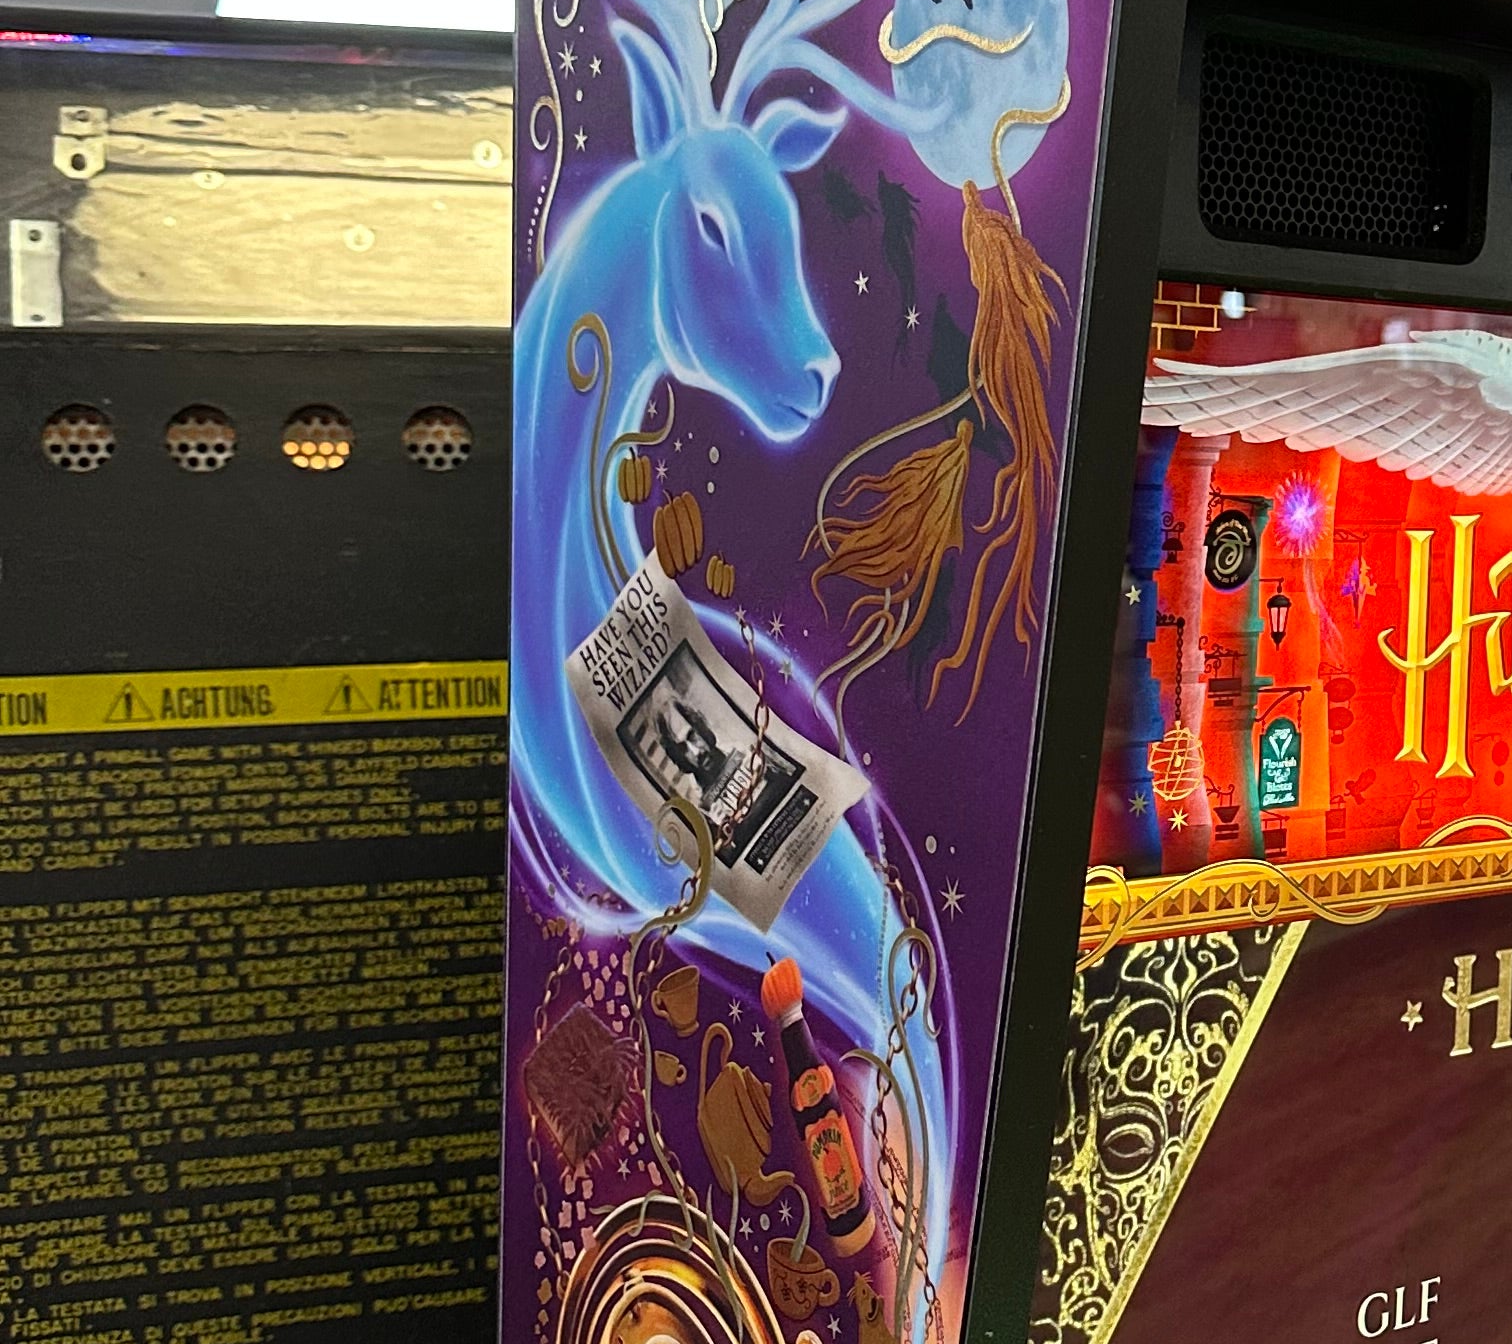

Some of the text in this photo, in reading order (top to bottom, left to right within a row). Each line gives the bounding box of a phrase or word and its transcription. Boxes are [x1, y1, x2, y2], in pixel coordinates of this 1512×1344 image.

[580, 568, 655, 673] HAVE YOU
[592, 592, 669, 698] SEEN THIS
[607, 622, 675, 714] WIZARD?
[161, 675, 501, 720] ACHTUNG ATTENTION
[276, 799, 478, 824] BACKBOX BOLTS ARE TO
[418, 819, 478, 835] INJURY
[330, 1189, 357, 1205] LA
[364, 1181, 439, 1201] TESTATA
[117, 1230, 143, 1245] LA
[153, 1221, 231, 1241] TESTATA
[32, 1272, 51, 1288] DI
[449, 1225, 475, 1242] LA
[13, 1308, 39, 1323] LA
[50, 1297, 127, 1318] TESTATA
[165, 1286, 224, 1304] TROVA
[1356, 1275, 1441, 1338] GLF
[144, 1325, 163, 1341] DI
[170, 1315, 242, 1337] QUESTE
